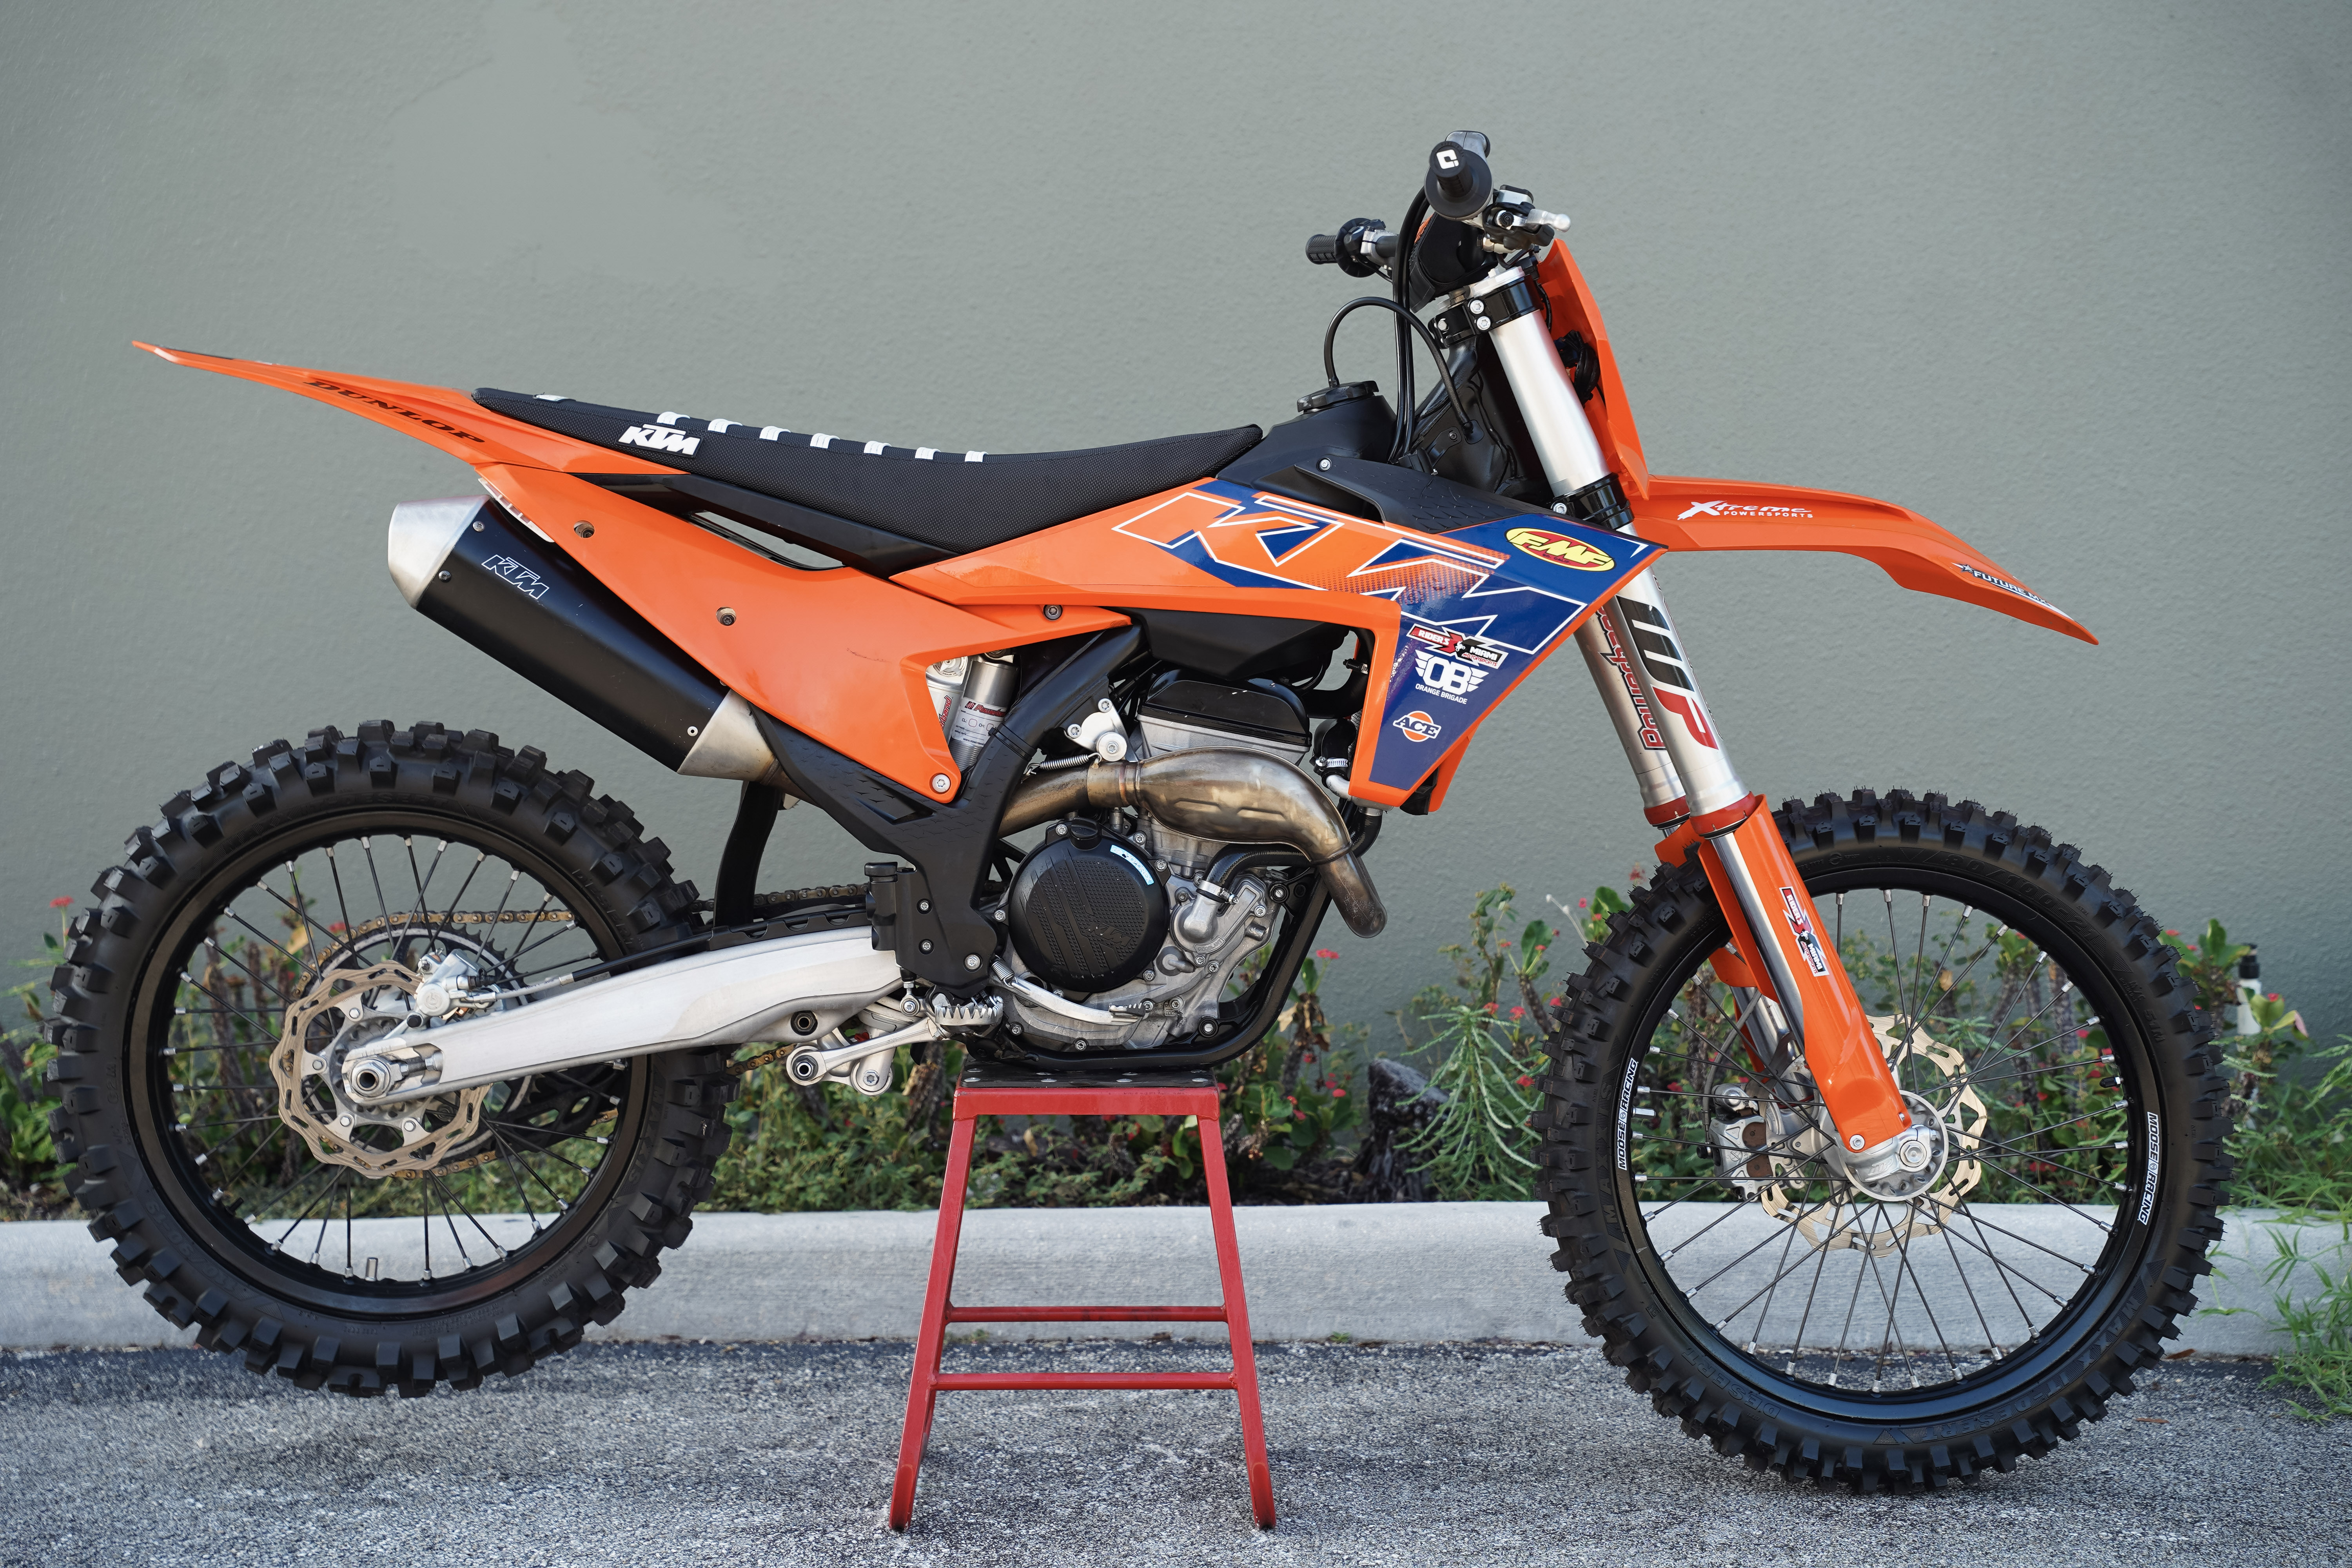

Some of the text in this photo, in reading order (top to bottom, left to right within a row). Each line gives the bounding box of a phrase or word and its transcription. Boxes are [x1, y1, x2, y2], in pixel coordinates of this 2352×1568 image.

[304, 381, 485, 443] DUNLOP
[619, 424, 701, 455] KTM
[1508, 532, 1613, 566] FMF
[481, 554, 550, 599] KTM
[1112, 492, 1588, 655] KTM
[1973, 571, 2026, 595] FUTURE
[1418, 630, 1498, 661] RIDERS MIAMI
[1461, 652, 1498, 666] MOTORSPORTS
[1415, 683, 1468, 705] ORANGE BRIGADE
[1423, 656, 1473, 695] OB
[1396, 717, 1440, 737] ACE
[1085, 922, 1132, 947] KTM
[1786, 894, 1823, 970] RIDERS MIAMI
[1617, 1058, 1638, 1170] MOOSE RACING
[1596, 1082, 1618, 1226] MAXXIS
[2138, 1112, 2159, 1225] MOOSE RACING
[2075, 1295, 2142, 1372] MAXX
[1680, 1345, 1781, 1420] DESERT
